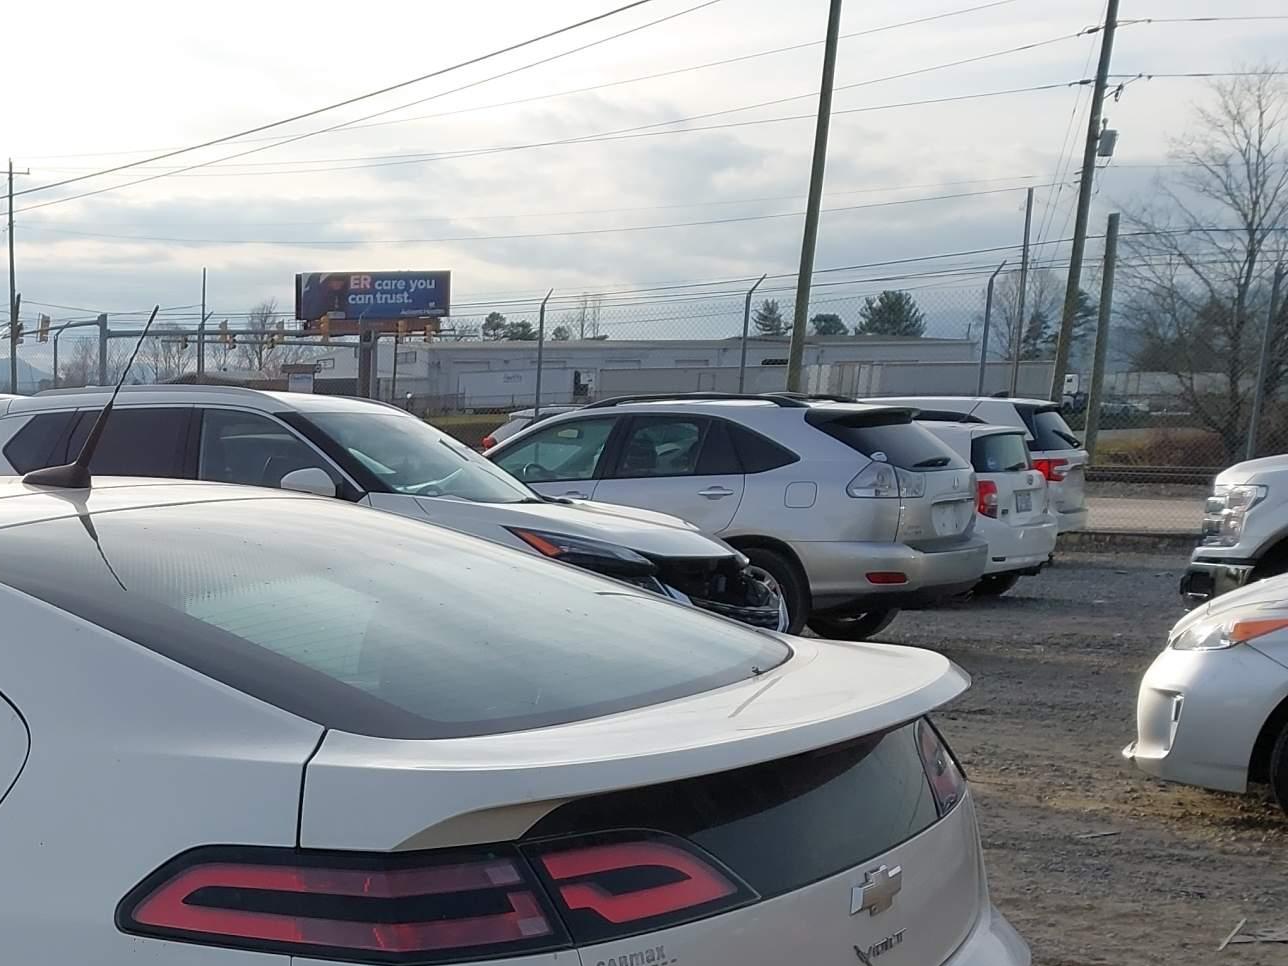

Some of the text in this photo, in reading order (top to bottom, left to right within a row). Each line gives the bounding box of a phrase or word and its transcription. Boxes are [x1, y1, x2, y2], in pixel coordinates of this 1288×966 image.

[350, 275, 436, 291] ER care you
[348, 291, 413, 304] can trust.
